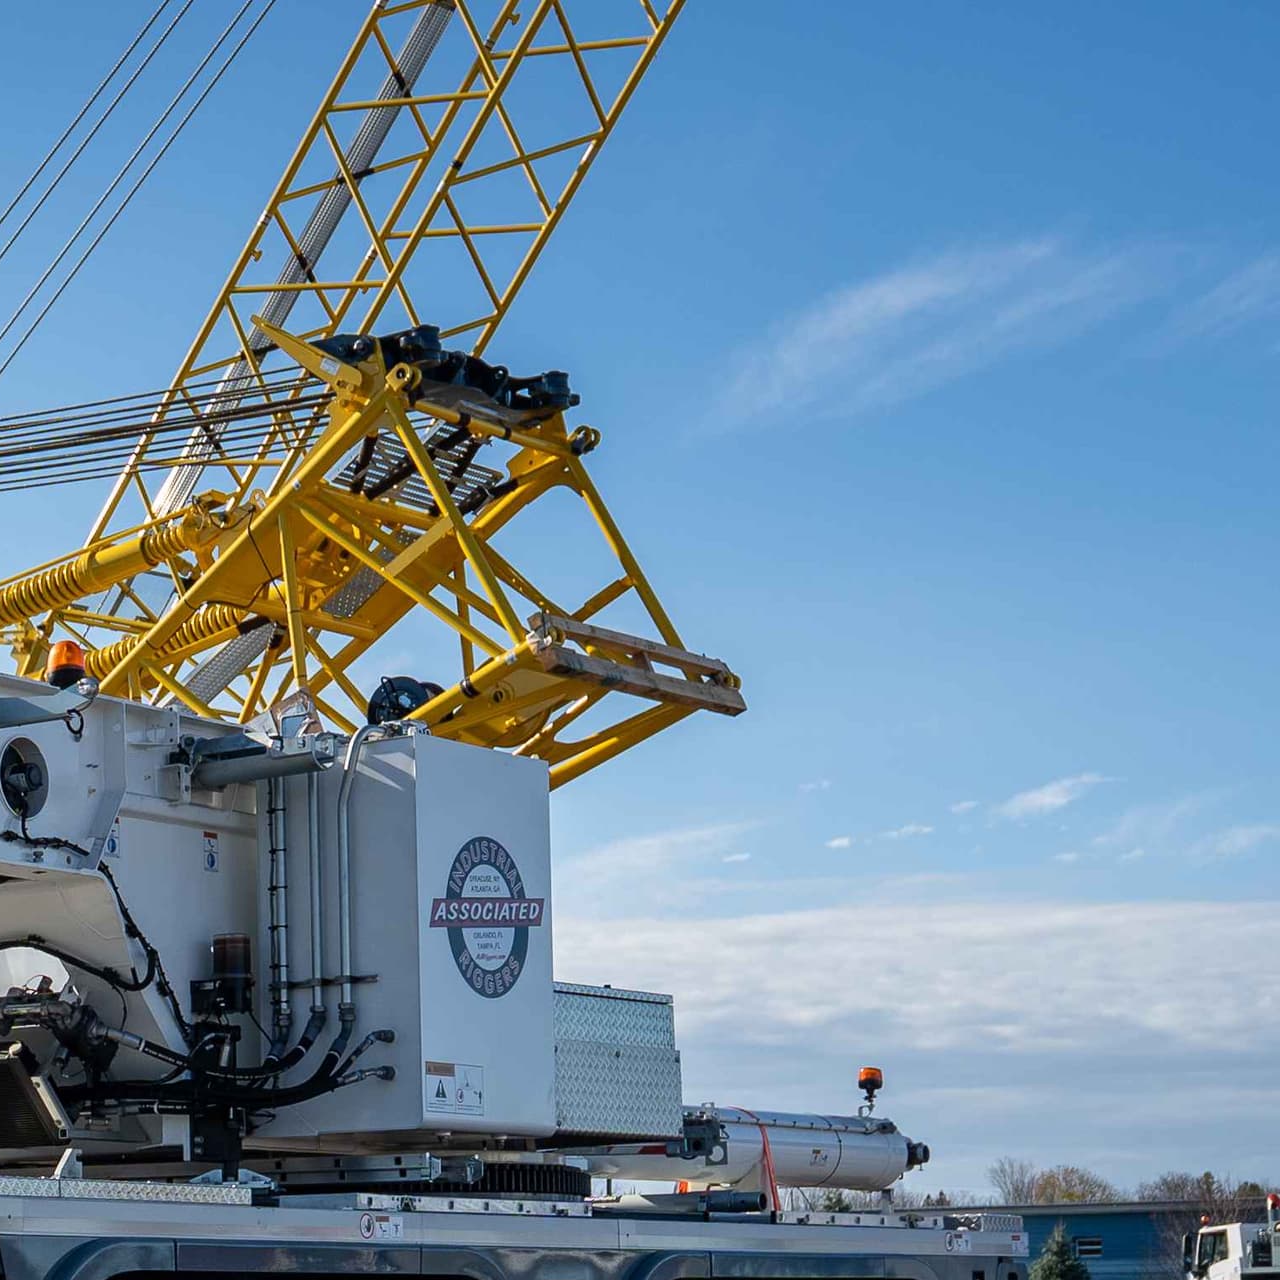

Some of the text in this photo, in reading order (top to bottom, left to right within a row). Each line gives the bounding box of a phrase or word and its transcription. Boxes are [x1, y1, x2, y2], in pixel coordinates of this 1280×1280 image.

[449, 840, 522, 898] INDUSTRIAL
[434, 902, 540, 920] ASSOCIATED
[458, 950, 520, 994] RIGGERS
